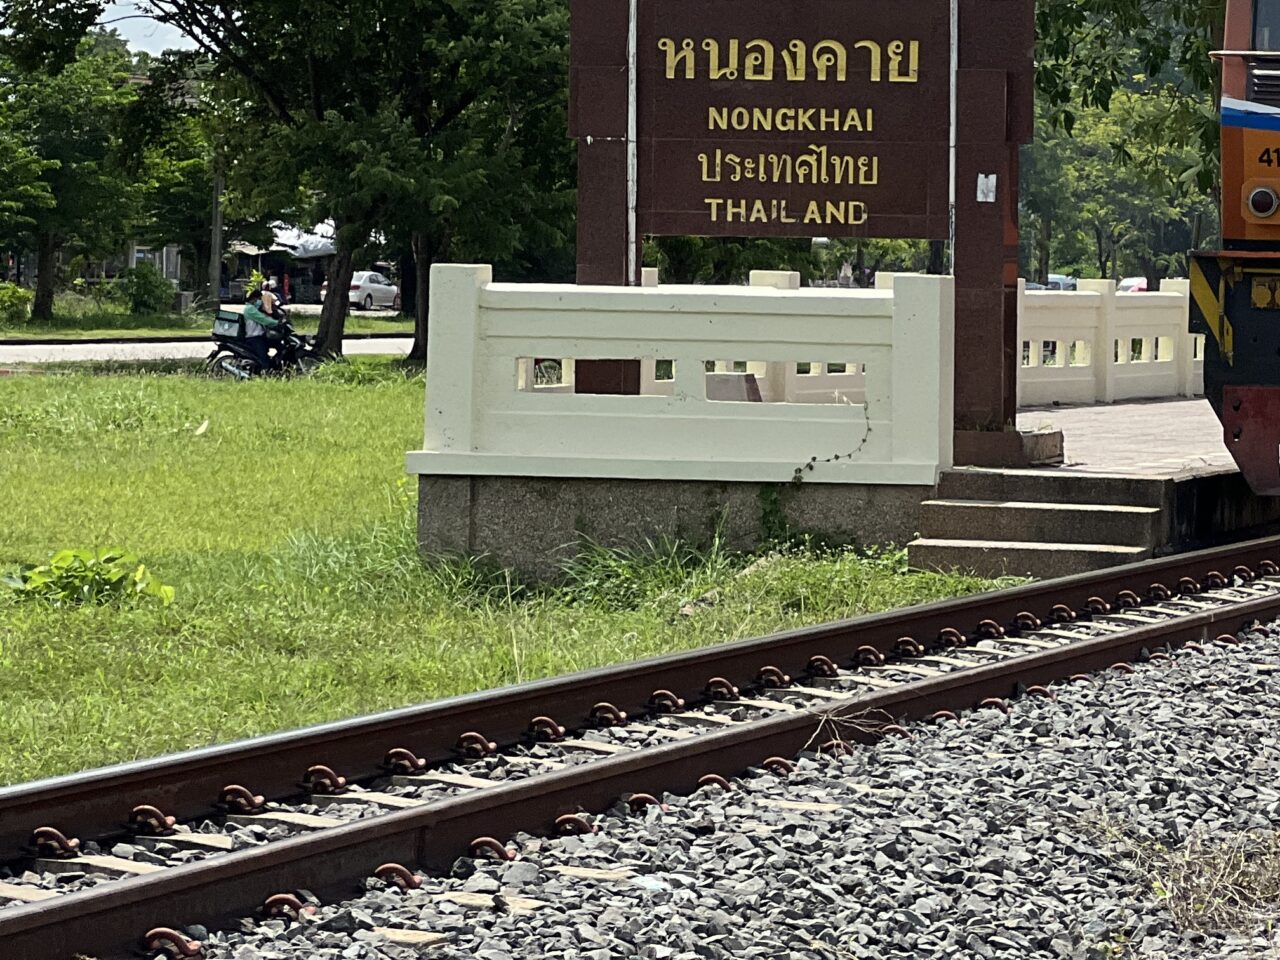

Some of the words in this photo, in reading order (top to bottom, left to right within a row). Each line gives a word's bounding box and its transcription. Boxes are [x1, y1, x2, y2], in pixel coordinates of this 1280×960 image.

[657, 37, 919, 83] หนองคาย
[708, 106, 873, 132] NONGKHAI
[697, 143, 879, 185] ประเทศไทย
[703, 198, 868, 225] THAILAND
